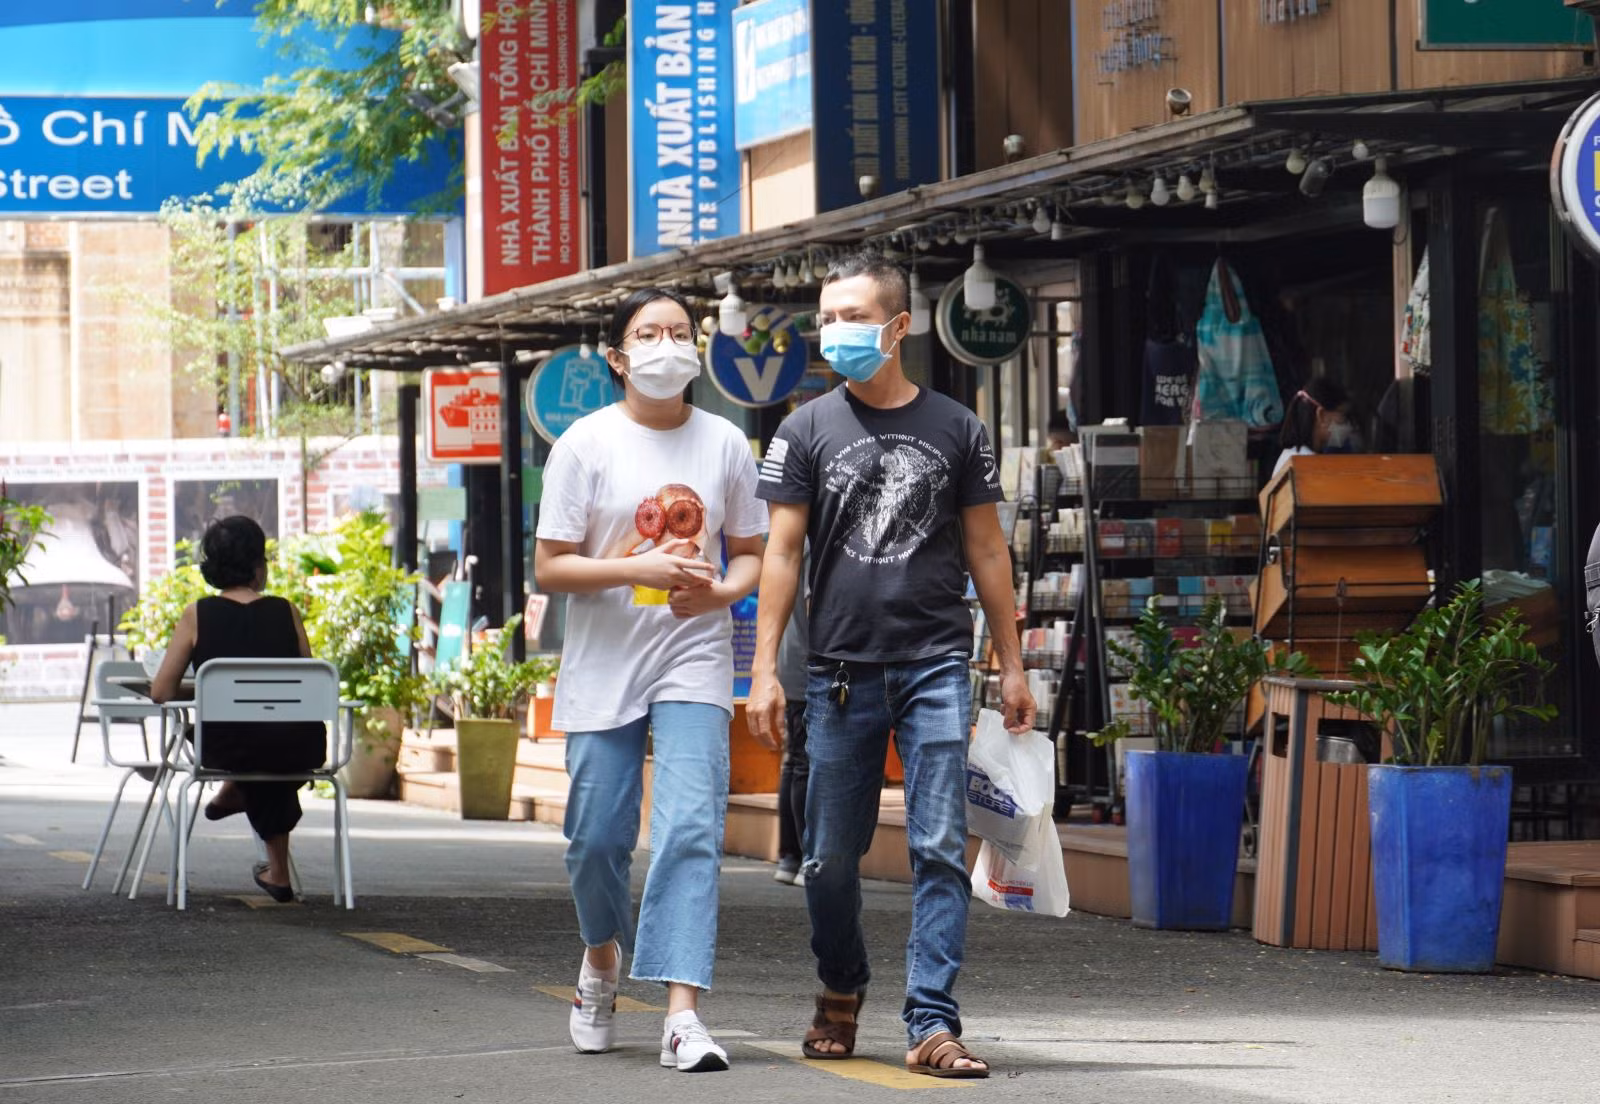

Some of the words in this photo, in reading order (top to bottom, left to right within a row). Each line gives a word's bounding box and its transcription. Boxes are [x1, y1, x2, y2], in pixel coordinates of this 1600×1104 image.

[644, 5, 692, 76] BẢN
[489, 40, 519, 101] TỔNG
[525, 53, 549, 91] CHÍ
[42, 109, 147, 146] Chí
[644, 82, 692, 168] XUẤT
[697, 28, 717, 189] PUBLISHING
[523, 133, 550, 183] PHỐ
[558, 160, 569, 187] CITY
[492, 157, 519, 214] XUẤT
[650, 174, 692, 246] NHÀ
[496, 219, 520, 266] NHÀ
[527, 188, 551, 266] THÀNH
[880, 433, 917, 443] WITHOUT
[858, 553, 895, 564] WITHOUT
